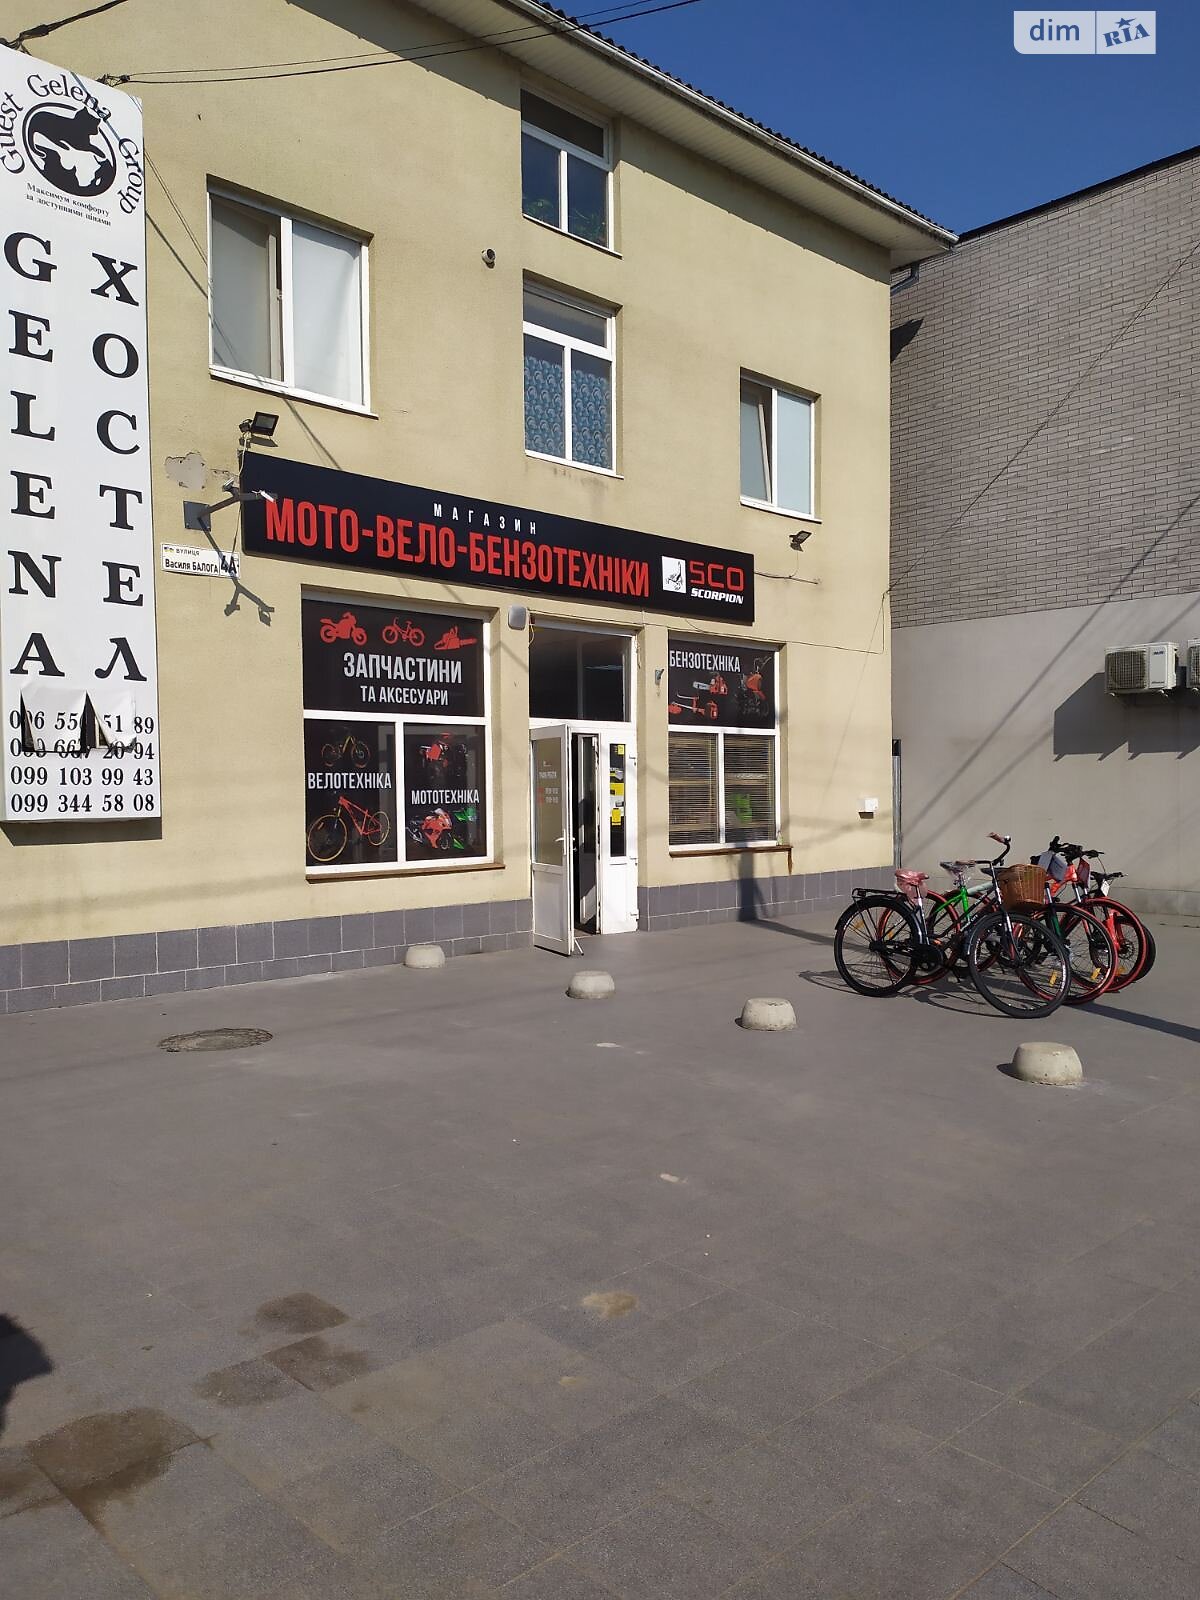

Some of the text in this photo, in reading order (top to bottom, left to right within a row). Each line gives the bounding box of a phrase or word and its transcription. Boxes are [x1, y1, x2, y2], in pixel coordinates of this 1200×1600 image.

[0, 73, 143, 214] Guest Gelena Group
[27, 182, 70, 203] Максимум
[3, 231, 66, 678] GELENA
[90, 252, 148, 682] ХОСТЕЛ
[433, 502, 536, 536] МАГАЗИН
[265, 497, 650, 598] МОТО-ВЕЛО-БЕНЗОТЕХНІКИ
[165, 558, 190, 570] Василя
[192, 562, 218, 573] БАЛОГА
[689, 560, 745, 591] SCO
[690, 587, 744, 604] SCORPION
[343, 652, 462, 684] ЗАПЧАСТИНИ
[669, 650, 741, 673] БЕНЗОТЕХНІКА
[360, 685, 449, 706] ТА АКСЕСУАРИ
[134, 716, 155, 735] 89
[134, 742, 155, 759] 94
[10, 765, 154, 786] 099 103 99 43
[308, 772, 392, 789] ВЕЛОТЕХНІКА
[11, 793, 155, 812] 099 344 58 08
[411, 789, 480, 805] МОТОТЕХНІКА
